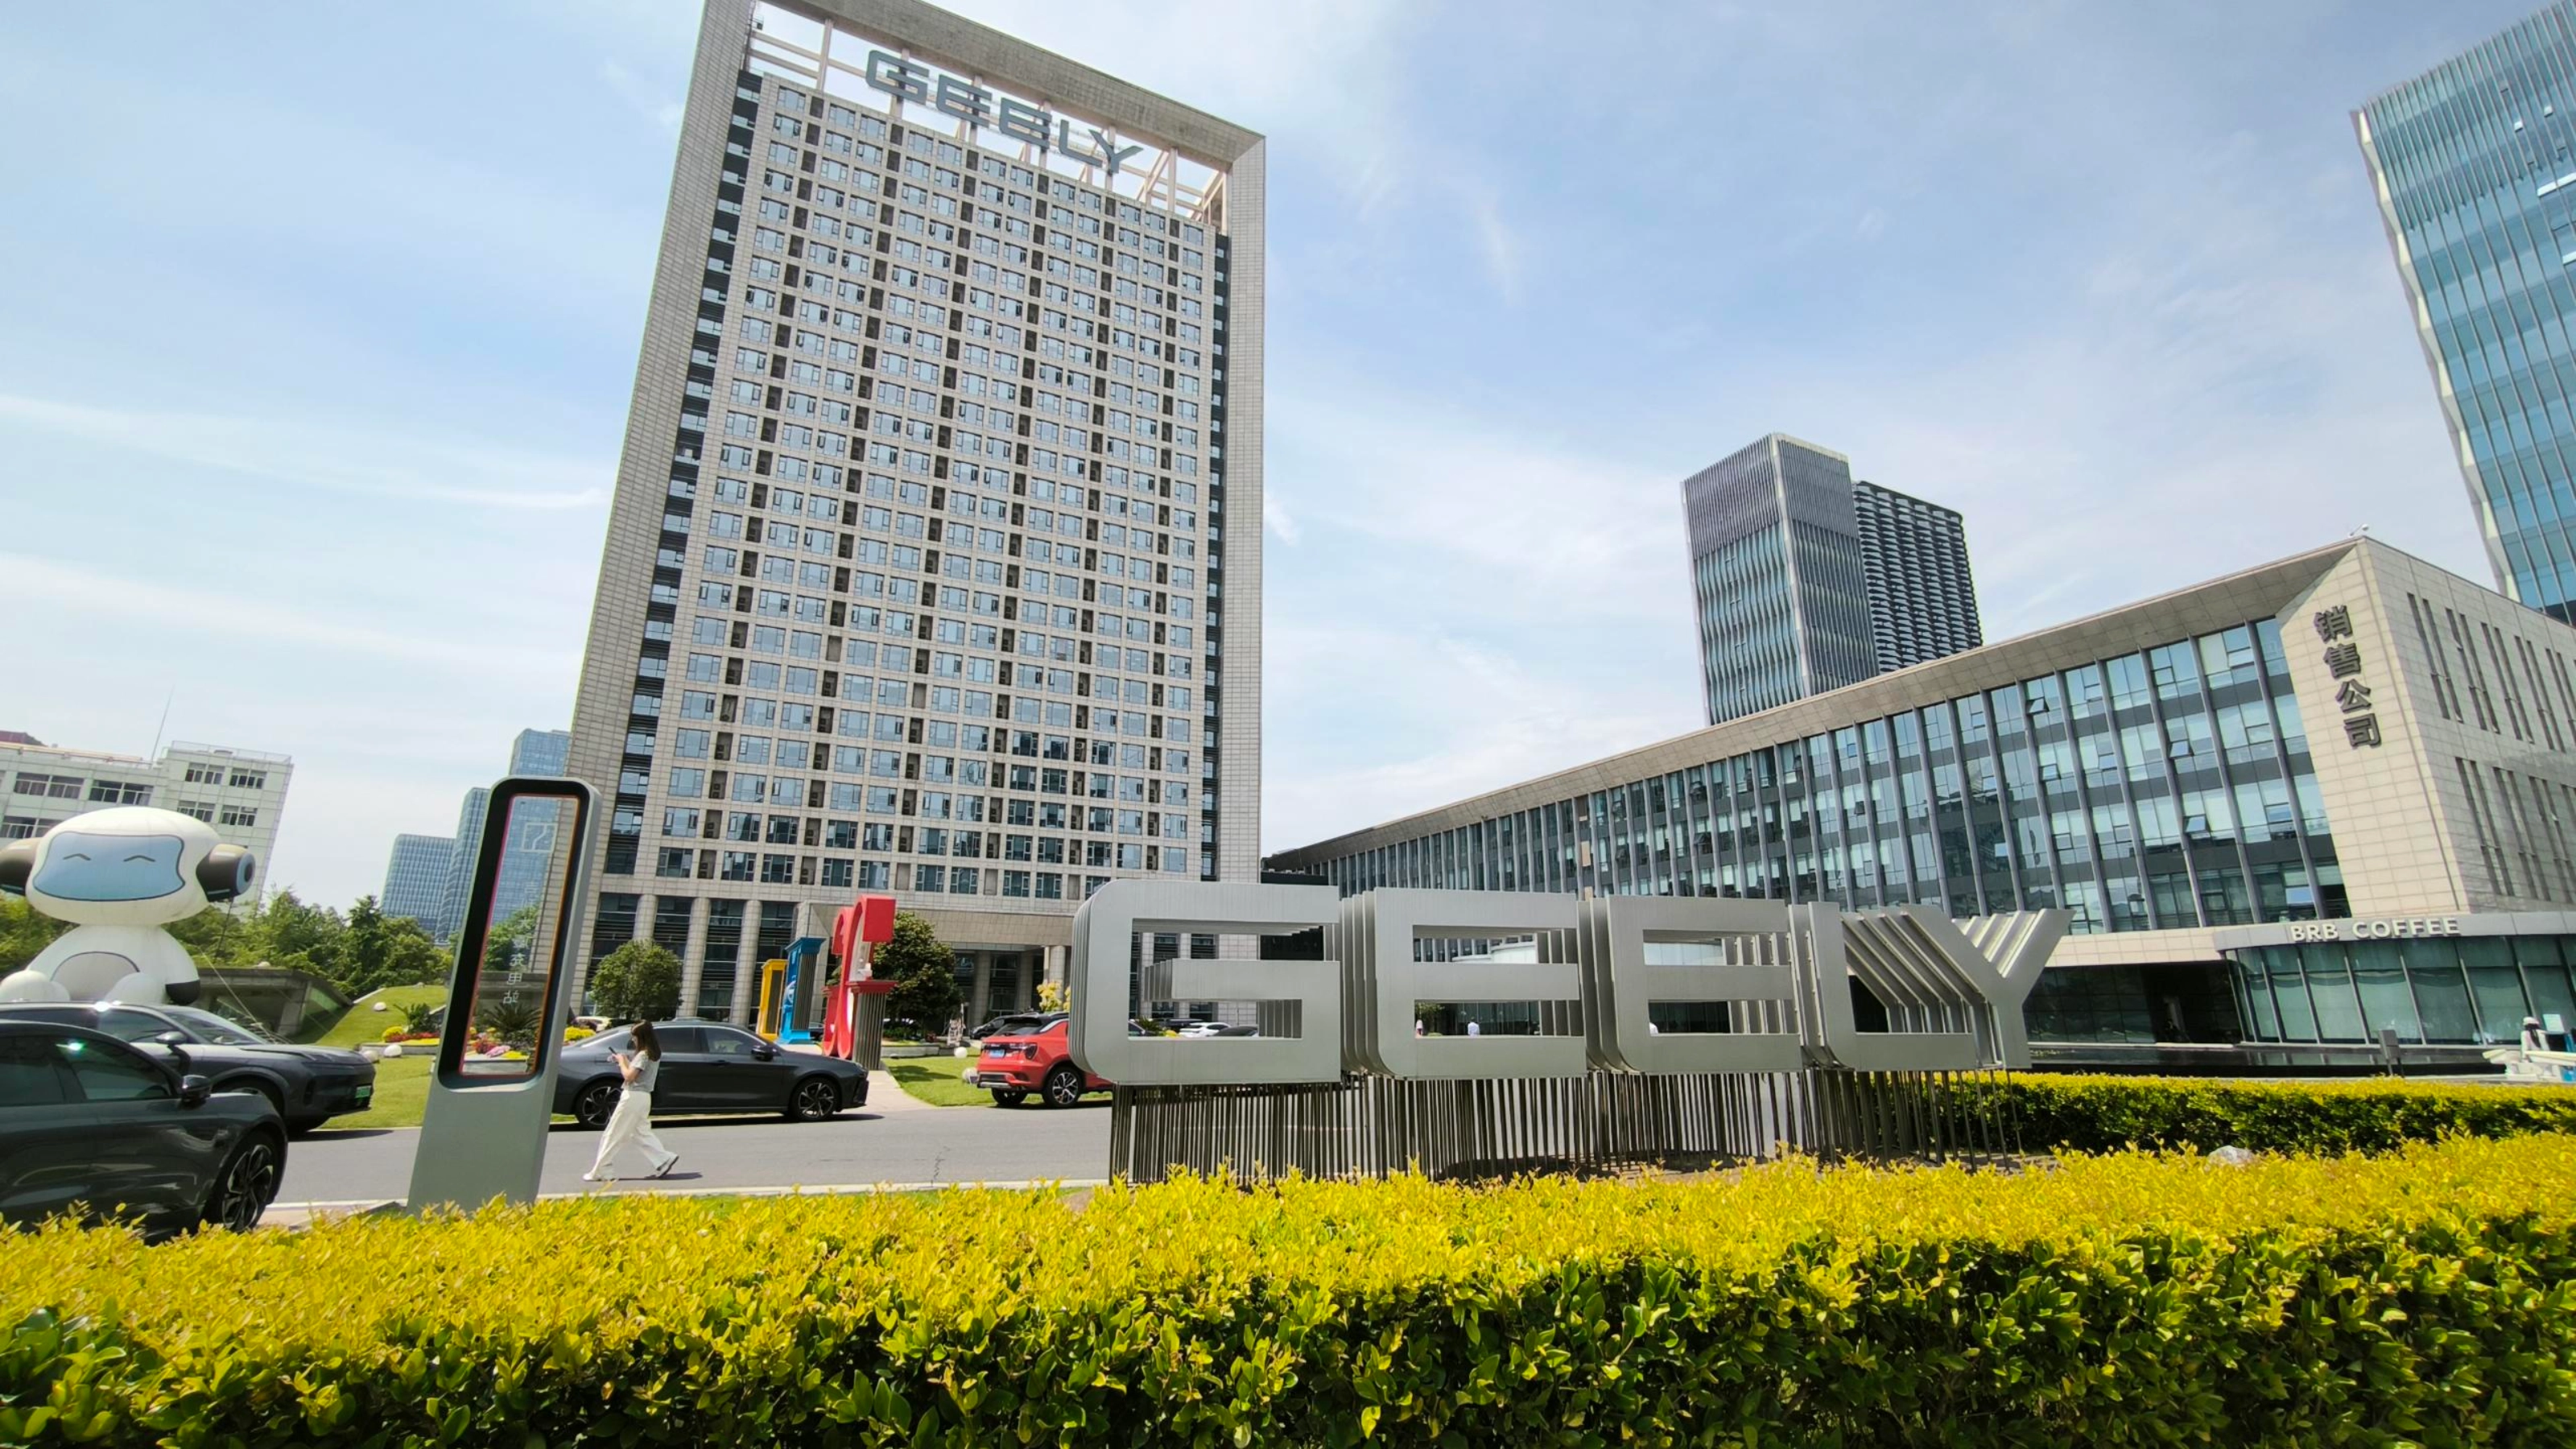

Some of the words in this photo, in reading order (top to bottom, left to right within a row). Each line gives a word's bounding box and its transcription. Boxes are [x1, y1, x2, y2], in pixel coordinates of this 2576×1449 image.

[865, 50, 1144, 174] GEELY
[2314, 605, 2382, 749] 销售公司
[1068, 879, 2075, 1085] GEELY
[2291, 923, 2339, 941] BRB
[2352, 918, 2460, 939] COFFEE
